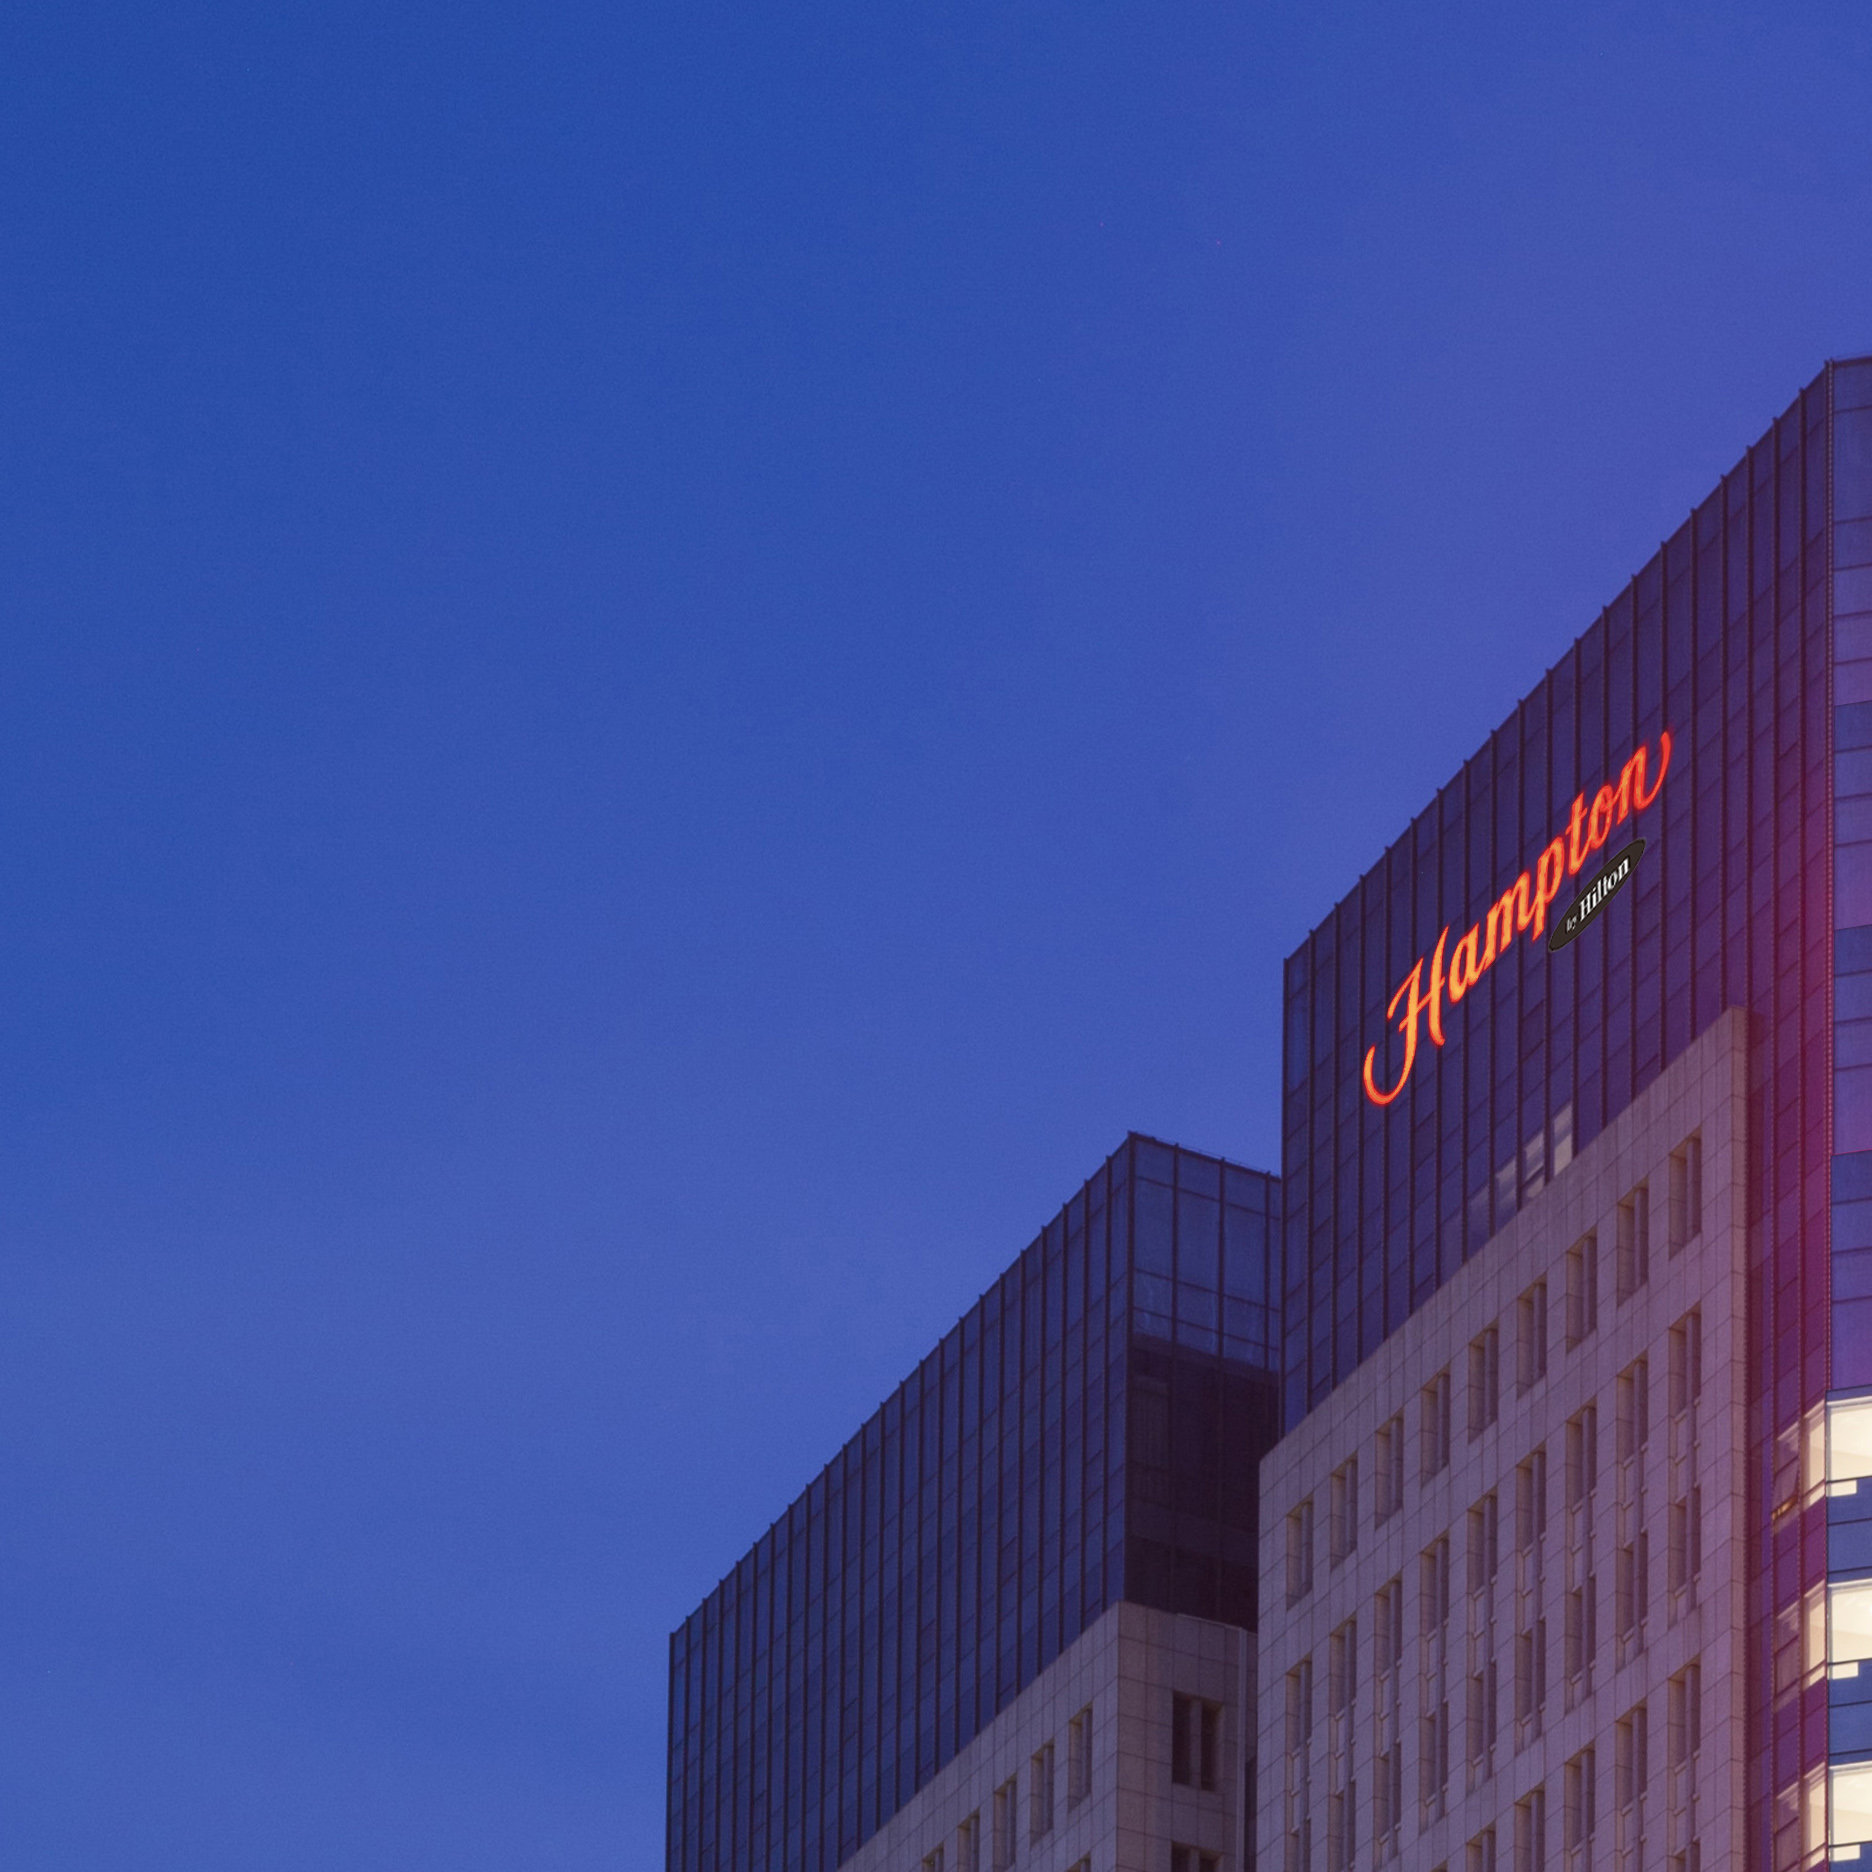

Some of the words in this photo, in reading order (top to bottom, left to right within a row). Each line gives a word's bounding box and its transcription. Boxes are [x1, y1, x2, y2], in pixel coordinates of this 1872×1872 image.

[1363, 731, 1672, 1105] Hampton
[1566, 915, 1577, 933] by
[1579, 857, 1629, 922] Hilton
